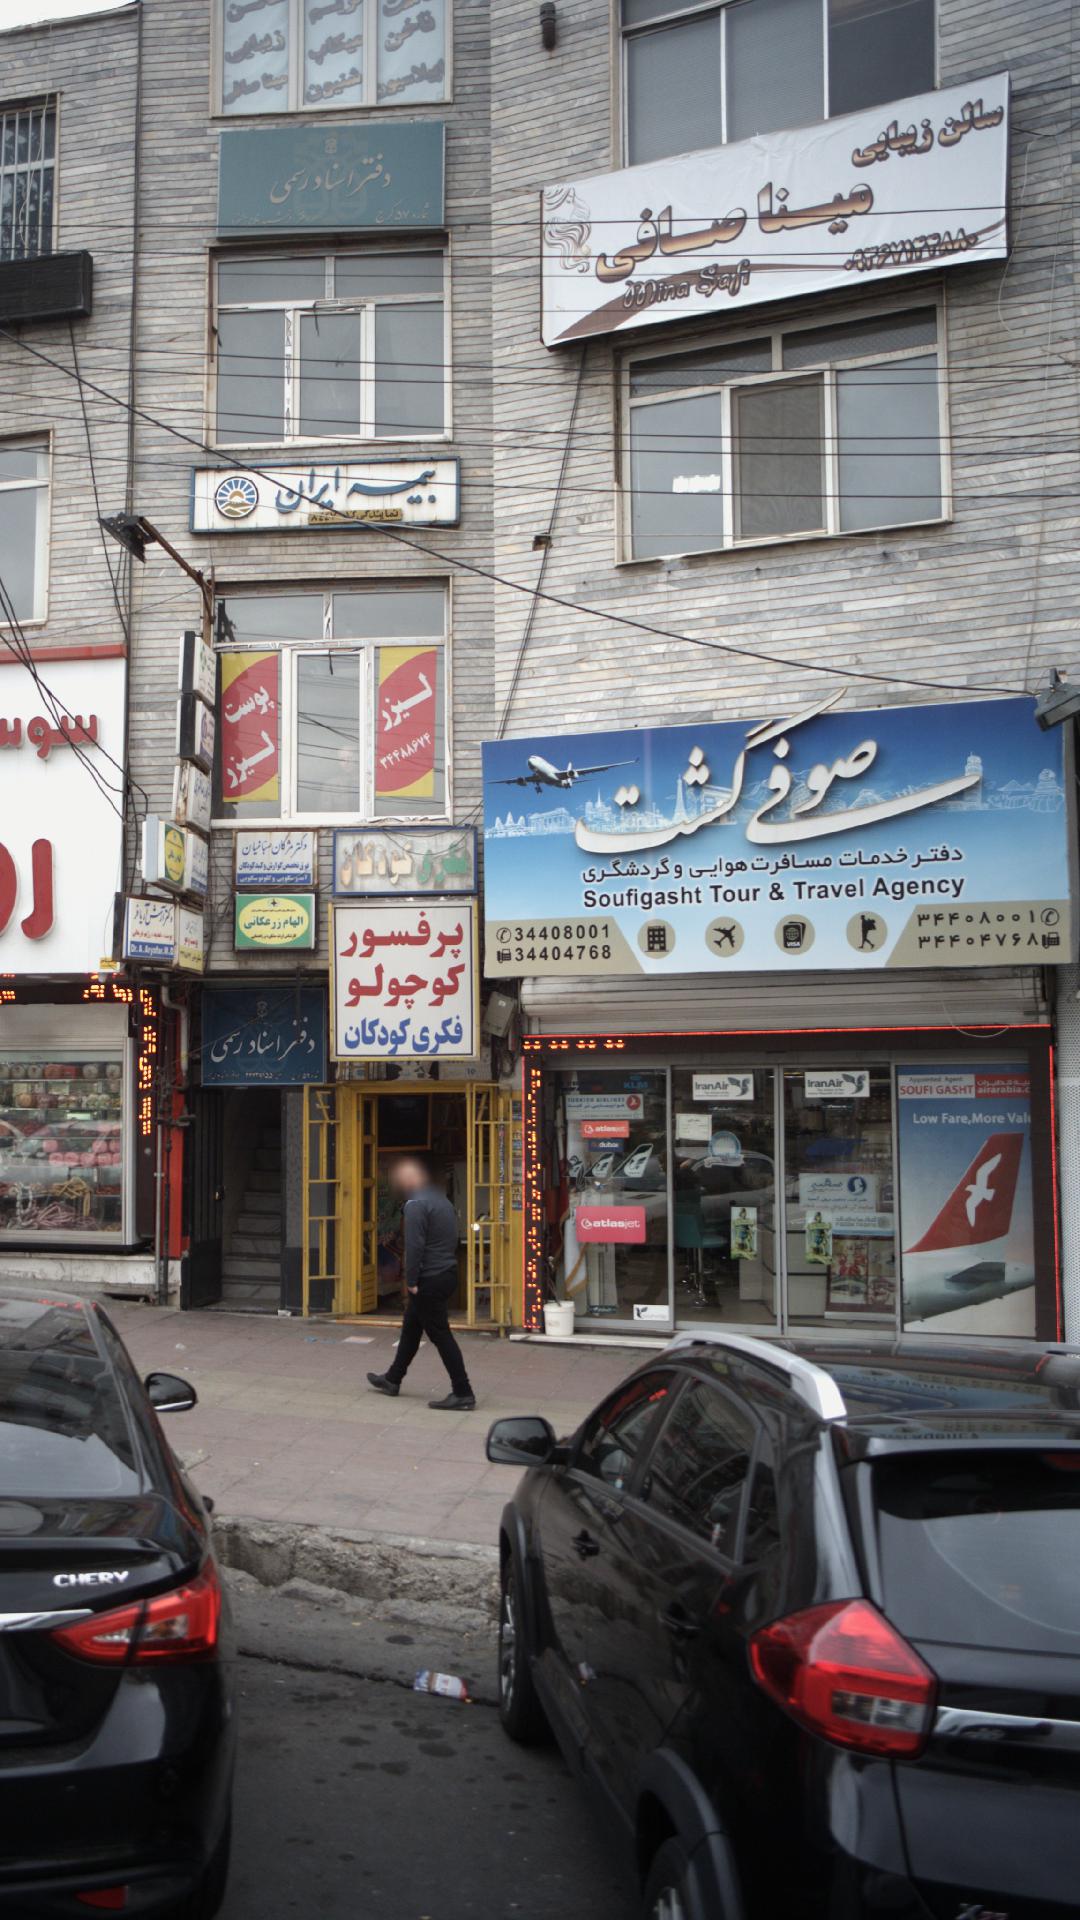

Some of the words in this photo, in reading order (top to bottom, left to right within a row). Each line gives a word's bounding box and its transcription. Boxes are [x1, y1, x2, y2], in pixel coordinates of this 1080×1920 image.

[938, 98, 1004, 147] سالن
[851, 118, 934, 168] زیبایی
[269, 167, 308, 204] رسمی
[312, 163, 354, 190] اسناد
[347, 153, 392, 196] دفتر
[756, 182, 875, 234] مینا
[595, 205, 748, 284] صافی
[623, 279, 691, 309] Mina
[696, 258, 751, 298] Safi
[275, 466, 341, 514] ایران
[347, 469, 436, 505] بیمه
[225, 685, 276, 724] پوست
[381, 671, 433, 732] لیزر
[227, 730, 276, 789] لیزر
[745, 737, 982, 846] صوفی
[582, 857, 671, 883] گردشگری
[674, 863, 683, 879] و
[689, 857, 748, 878] هوایی
[751, 853, 833, 875] مسافرت
[839, 847, 908, 867] خدمات
[911, 845, 964, 868] دفتر
[583, 886, 703, 910] Soufigasht
[709, 885, 761, 903] Tour
[769, 882, 785, 900] &
[793, 878, 864, 900] Travel
[872, 877, 965, 901] Agency
[514, 924, 609, 942] 34408001
[917, 910, 1035, 927] ۳۴۴۰۸۰۰۱
[339, 911, 464, 959] پرفسور
[917, 932, 1039, 949] ۳۴۴۰۴۷۶۸
[514, 944, 611, 962] 34404768
[344, 963, 466, 1010] کوچولو
[210, 1031, 243, 1063] رسمی
[247, 1030, 281, 1055] اسناد
[277, 1016, 316, 1061] دفتر
[344, 1017, 411, 1055] کودکان
[412, 1015, 463, 1054] فکری
[695, 1081, 730, 1091] IranAir
[807, 1078, 844, 1088] IranAir
[900, 1085, 933, 1095] SOUFI
[936, 1085, 973, 1095] GASHT
[913, 1113, 938, 1124] Low
[592, 1218, 641, 1229] atlasjet
[53, 1570, 129, 1588] CHERY
